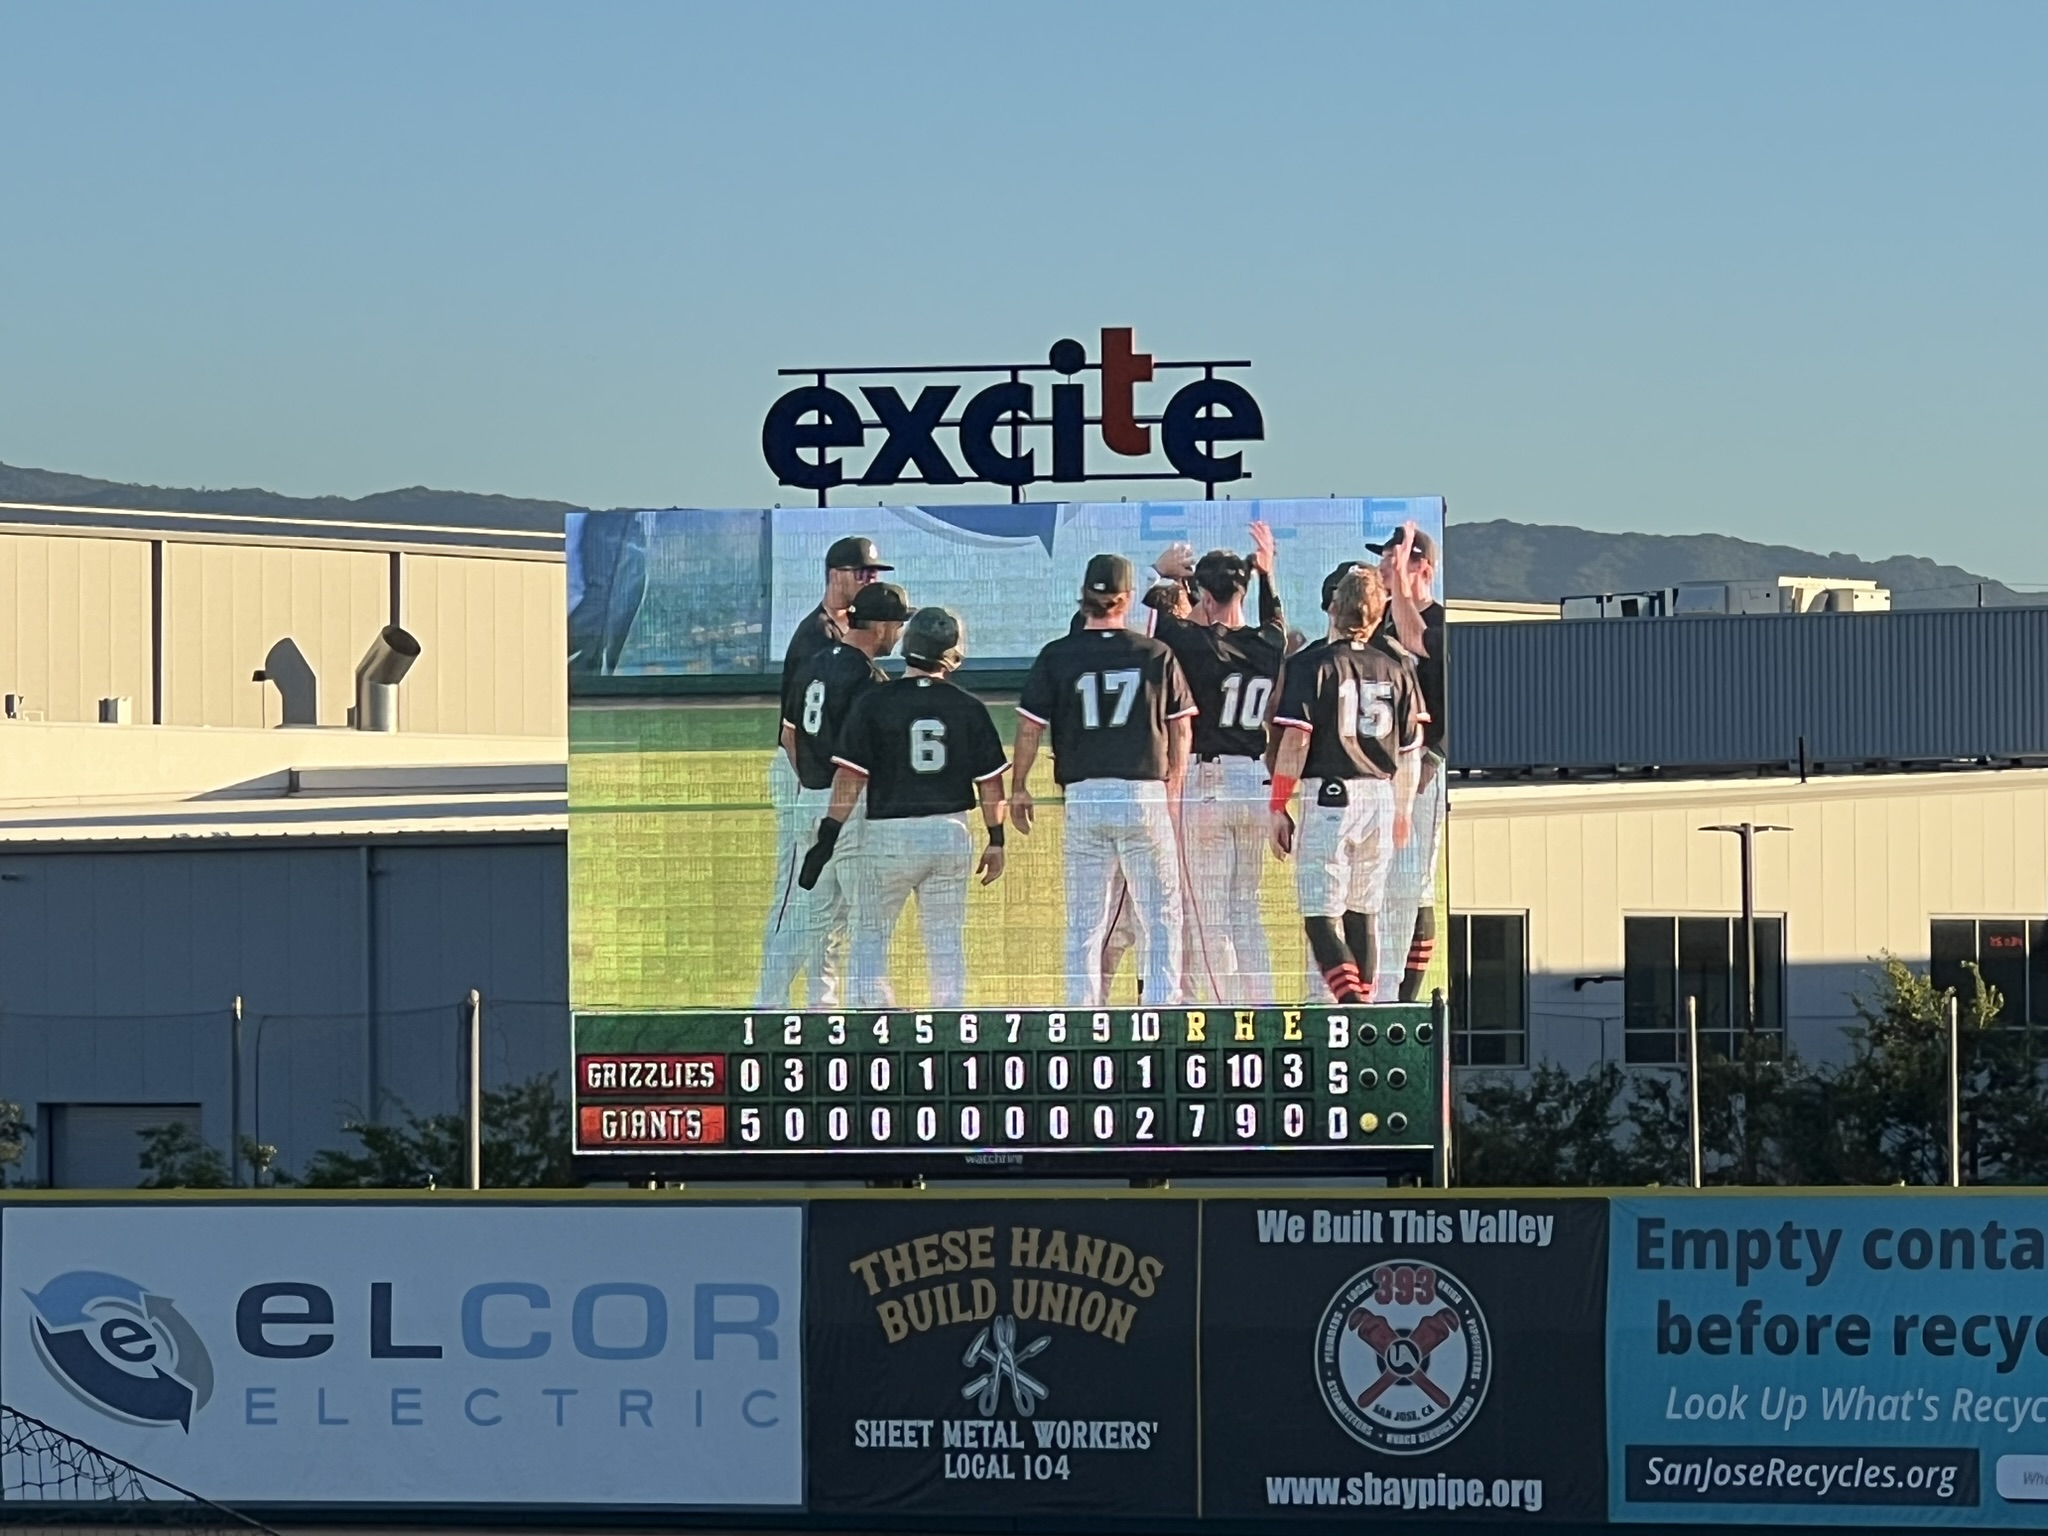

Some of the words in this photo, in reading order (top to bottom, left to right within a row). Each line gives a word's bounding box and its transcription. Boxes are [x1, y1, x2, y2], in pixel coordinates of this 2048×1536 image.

[762, 327, 1264, 489] excite
[802, 679, 826, 736] 8
[1075, 668, 1141, 730] 17
[1218, 673, 1273, 730] 10
[1338, 680, 1393, 738] 15
[909, 717, 947, 774] 6
[744, 1016, 754, 1045] 1
[784, 1016, 801, 1045] 2
[828, 1016, 846, 1045] 3
[873, 1015, 889, 1044] 4
[916, 1014, 933, 1044] 5
[960, 1014, 977, 1044] 6
[1005, 1014, 1021, 1043] 7
[1049, 1013, 1066, 1042] 8
[1093, 1013, 1109, 1042] 9
[1131, 1012, 1159, 1042] 10
[1186, 1011, 1206, 1041] R
[1234, 1011, 1254, 1041] H
[1283, 1011, 1303, 1040] E
[1327, 1015, 1349, 1048] B
[588, 1062, 715, 1088] GRIZZLIES
[741, 1058, 760, 1092] 0
[784, 1058, 804, 1092] 3
[828, 1058, 848, 1091] 0
[870, 1057, 890, 1091] 0
[918, 1057, 932, 1090] 1
[963, 1056, 977, 1090] 1
[1004, 1056, 1024, 1090] 0
[1049, 1056, 1069, 1090] 0
[1093, 1056, 1113, 1089] 0
[1137, 1055, 1151, 1088] 1
[1186, 1055, 1206, 1088] 6
[1227, 1054, 1262, 1088] 10
[1283, 1053, 1303, 1088] 3
[1328, 1061, 1348, 1094] S
[602, 1110, 701, 1139] GIANTS
[741, 1108, 760, 1141] 5
[785, 1108, 805, 1141] 0
[828, 1107, 848, 1141] 0
[871, 1107, 891, 1141] 0
[917, 1106, 936, 1140] 0
[961, 1106, 980, 1140] 0
[1005, 1106, 1025, 1140] 0
[1049, 1106, 1069, 1139] 0
[1094, 1105, 1114, 1139] 0
[1136, 1107, 1154, 1139] 2
[1189, 1105, 1205, 1137] 7
[1236, 1104, 1256, 1138] 9
[1283, 1104, 1304, 1137] 0
[1257, 1209, 1305, 1243] We
[1313, 1209, 1383, 1243] Built
[1390, 1209, 1453, 1243] This
[1460, 1209, 1554, 1247] Valley
[849, 1226, 995, 1295] THESE
[1010, 1227, 1164, 1298] HANDS
[1636, 1216, 1843, 1287] Empty
[1862, 1220, 2046, 1271] conta
[1373, 1266, 1436, 1306] 393
[876, 1278, 997, 1344] BUILD
[1011, 1278, 1138, 1344] UNION
[1656, 1300, 1871, 1357] before
[245, 1387, 780, 1429] ELECTRIC
[1665, 1384, 1749, 1420] Look
[1760, 1387, 1807, 1431] Up
[1822, 1386, 1939, 1422] What's
[854, 1419, 934, 1448] SHEET
[942, 1420, 1025, 1449] METAL
[1032, 1420, 1158, 1450] WORKERS'
[944, 1453, 1016, 1480] LOCAL
[1023, 1454, 1071, 1481] 104
[1645, 1456, 1958, 1498] SanJoseRecycles.org
[1265, 1472, 1543, 1511] www.sbaypipe.org
